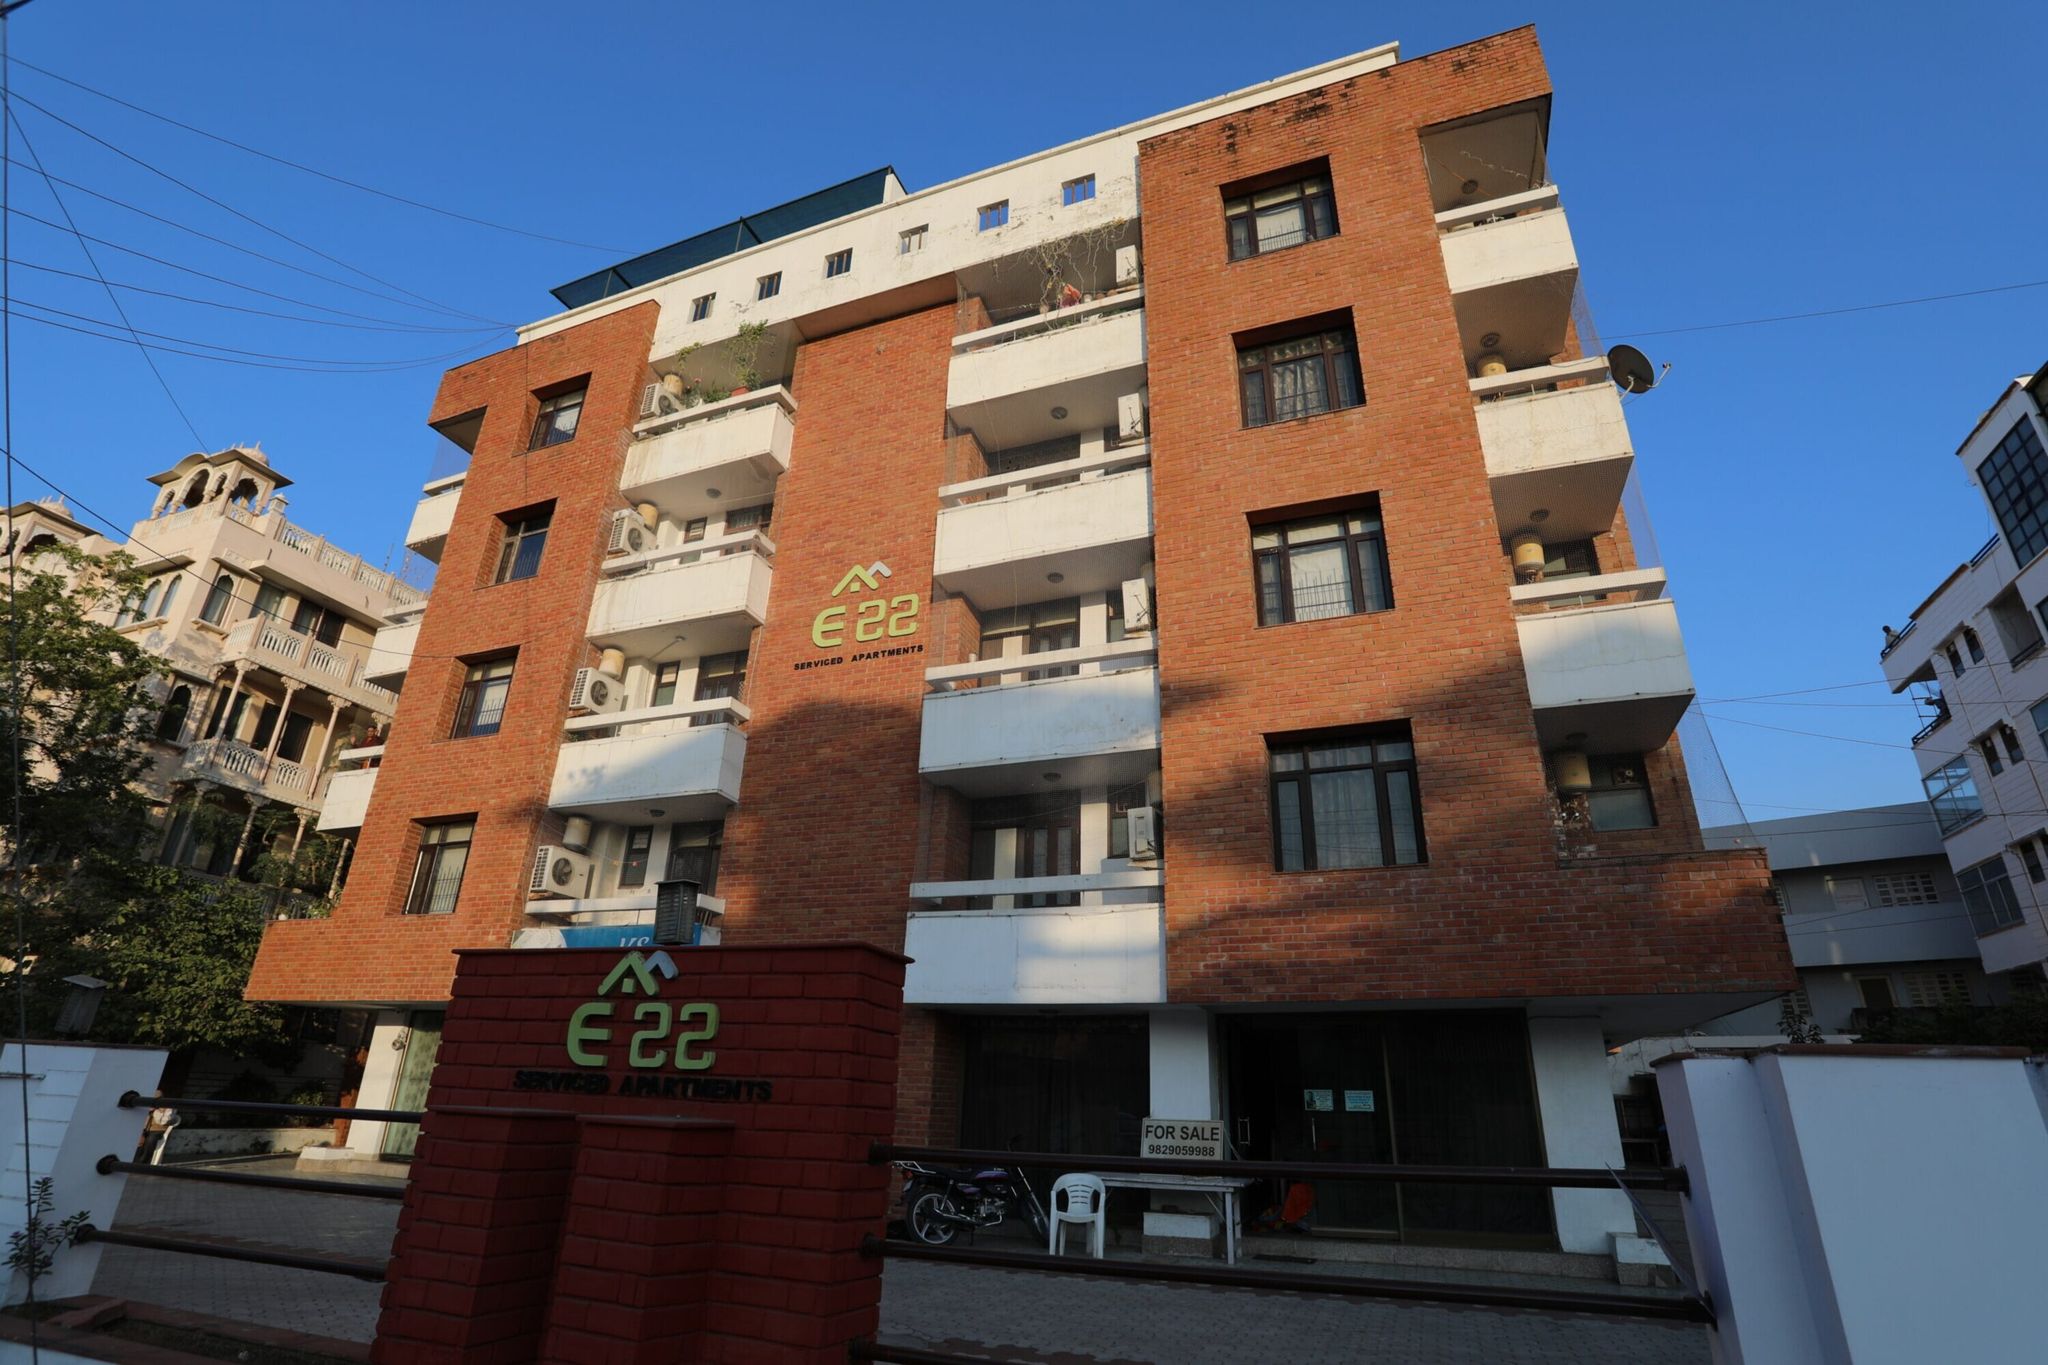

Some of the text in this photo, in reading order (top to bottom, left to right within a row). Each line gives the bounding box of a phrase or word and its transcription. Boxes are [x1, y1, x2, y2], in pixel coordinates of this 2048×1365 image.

[794, 644, 924, 671] SERVICED APARTMENTS
[513, 1070, 773, 1101] SERVICED APARTMENTS
[1145, 1125, 1220, 1141] FOR SALE
[1148, 1144, 1215, 1156] 9829059988
